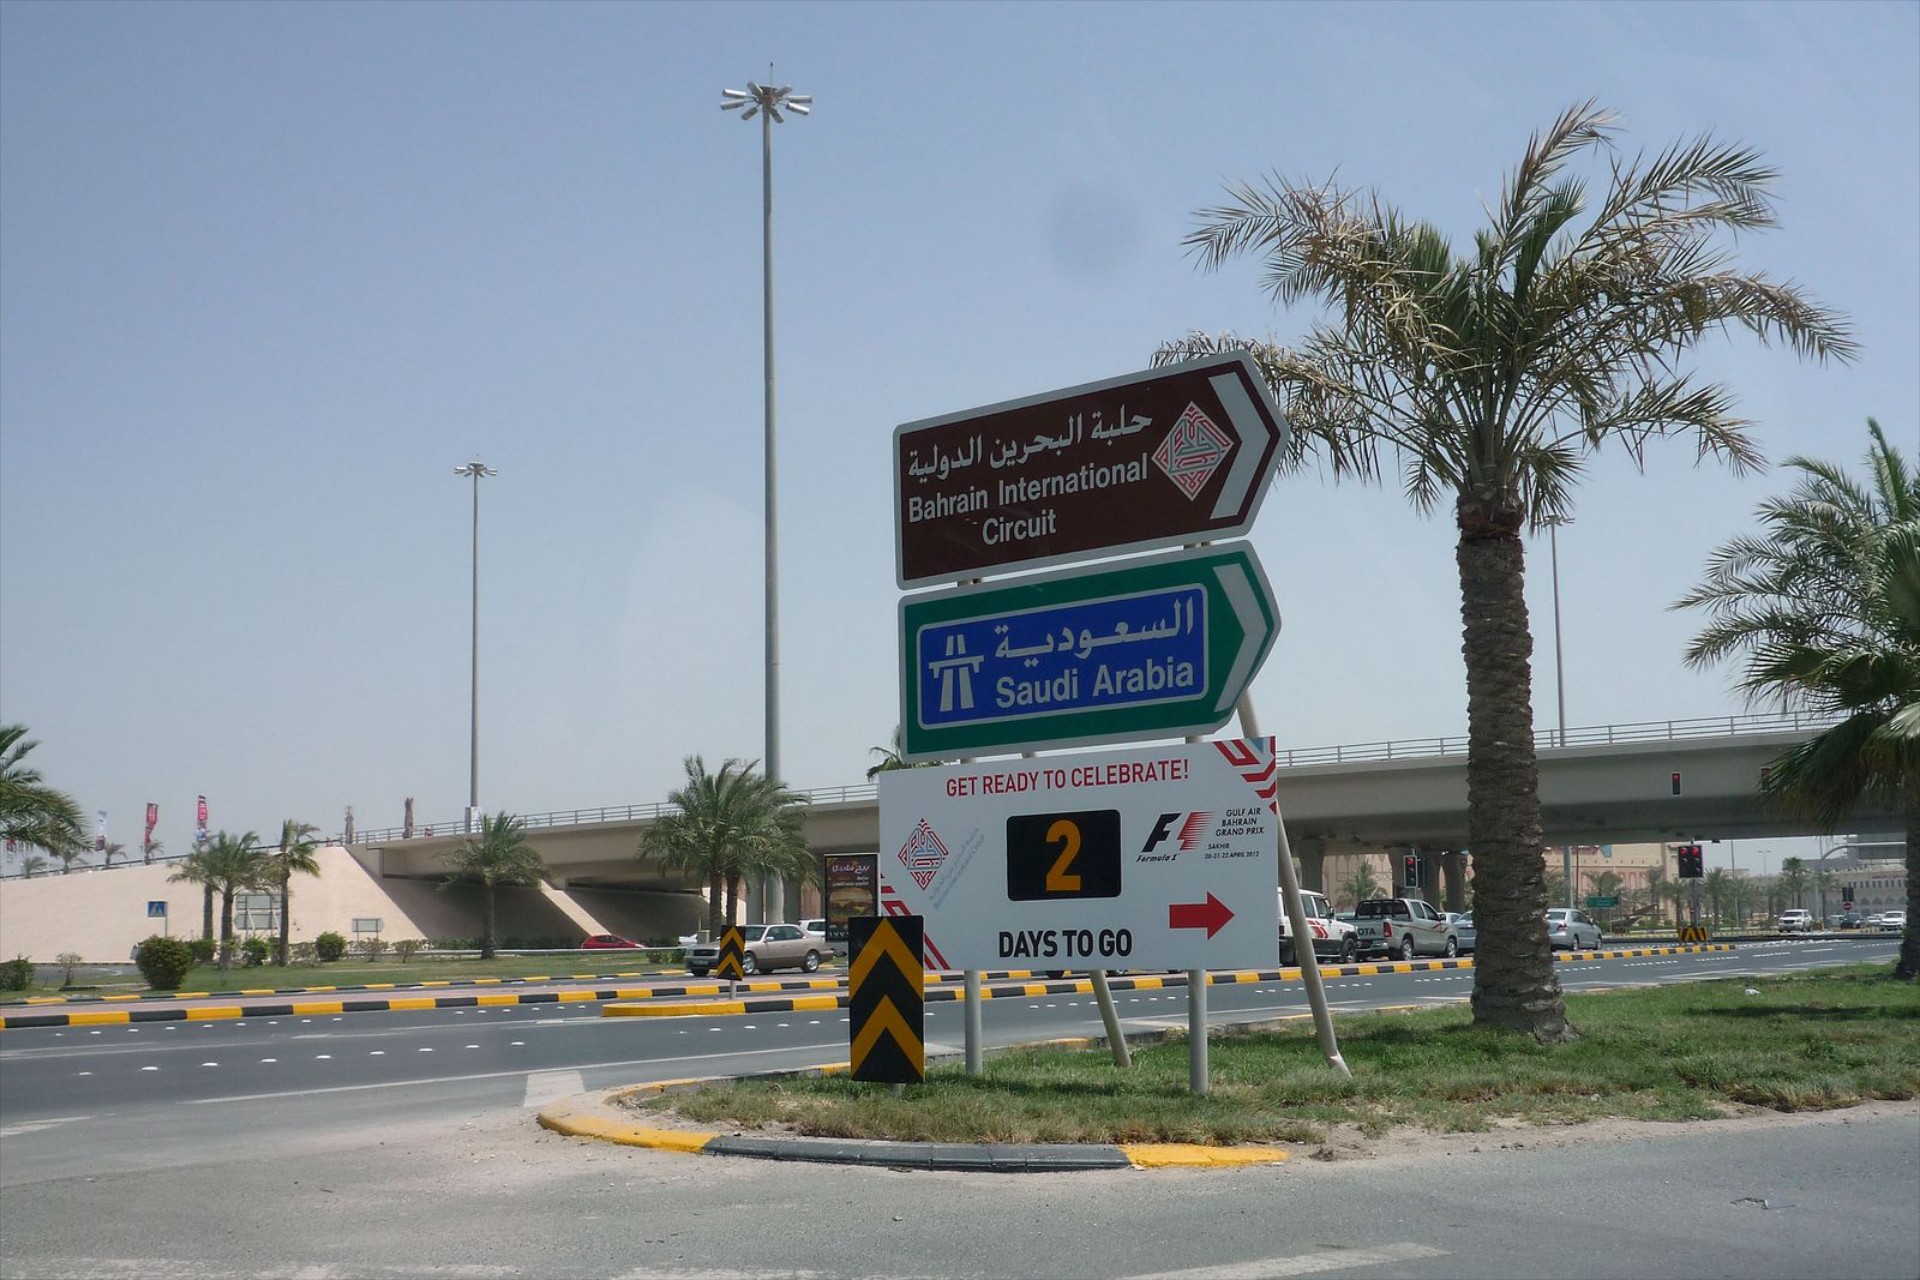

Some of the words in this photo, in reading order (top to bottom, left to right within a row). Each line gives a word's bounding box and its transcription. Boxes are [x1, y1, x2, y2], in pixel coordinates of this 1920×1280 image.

[990, 412, 1083, 469] البحرين
[1091, 404, 1153, 446] حلبة
[909, 434, 983, 484] الدولية
[909, 486, 988, 522] Bahrain
[999, 452, 1148, 507] International
[982, 509, 1057, 546] Circuit
[994, 596, 1194, 668] السعودية
[996, 669, 1078, 709] Saudi
[1092, 656, 1194, 698] Arabia
[946, 776, 978, 797] GET
[982, 771, 1039, 794] READY
[1043, 769, 1066, 789] TO
[1071, 759, 1189, 787] CELEBRATE!
[1222, 818, 1258, 827] BAHRAIN
[1226, 808, 1246, 817] GULF
[1248, 807, 1261, 815] AIR
[1215, 828, 1244, 837] GRAND
[1246, 826, 1265, 836] PRIX
[1046, 819, 1081, 891] 2
[1136, 854, 1171, 863] Formula
[999, 930, 1058, 958] DAYS
[1062, 929, 1093, 957] TO
[1098, 928, 1132, 957] GO
[1357, 928, 1376, 936] OTA
